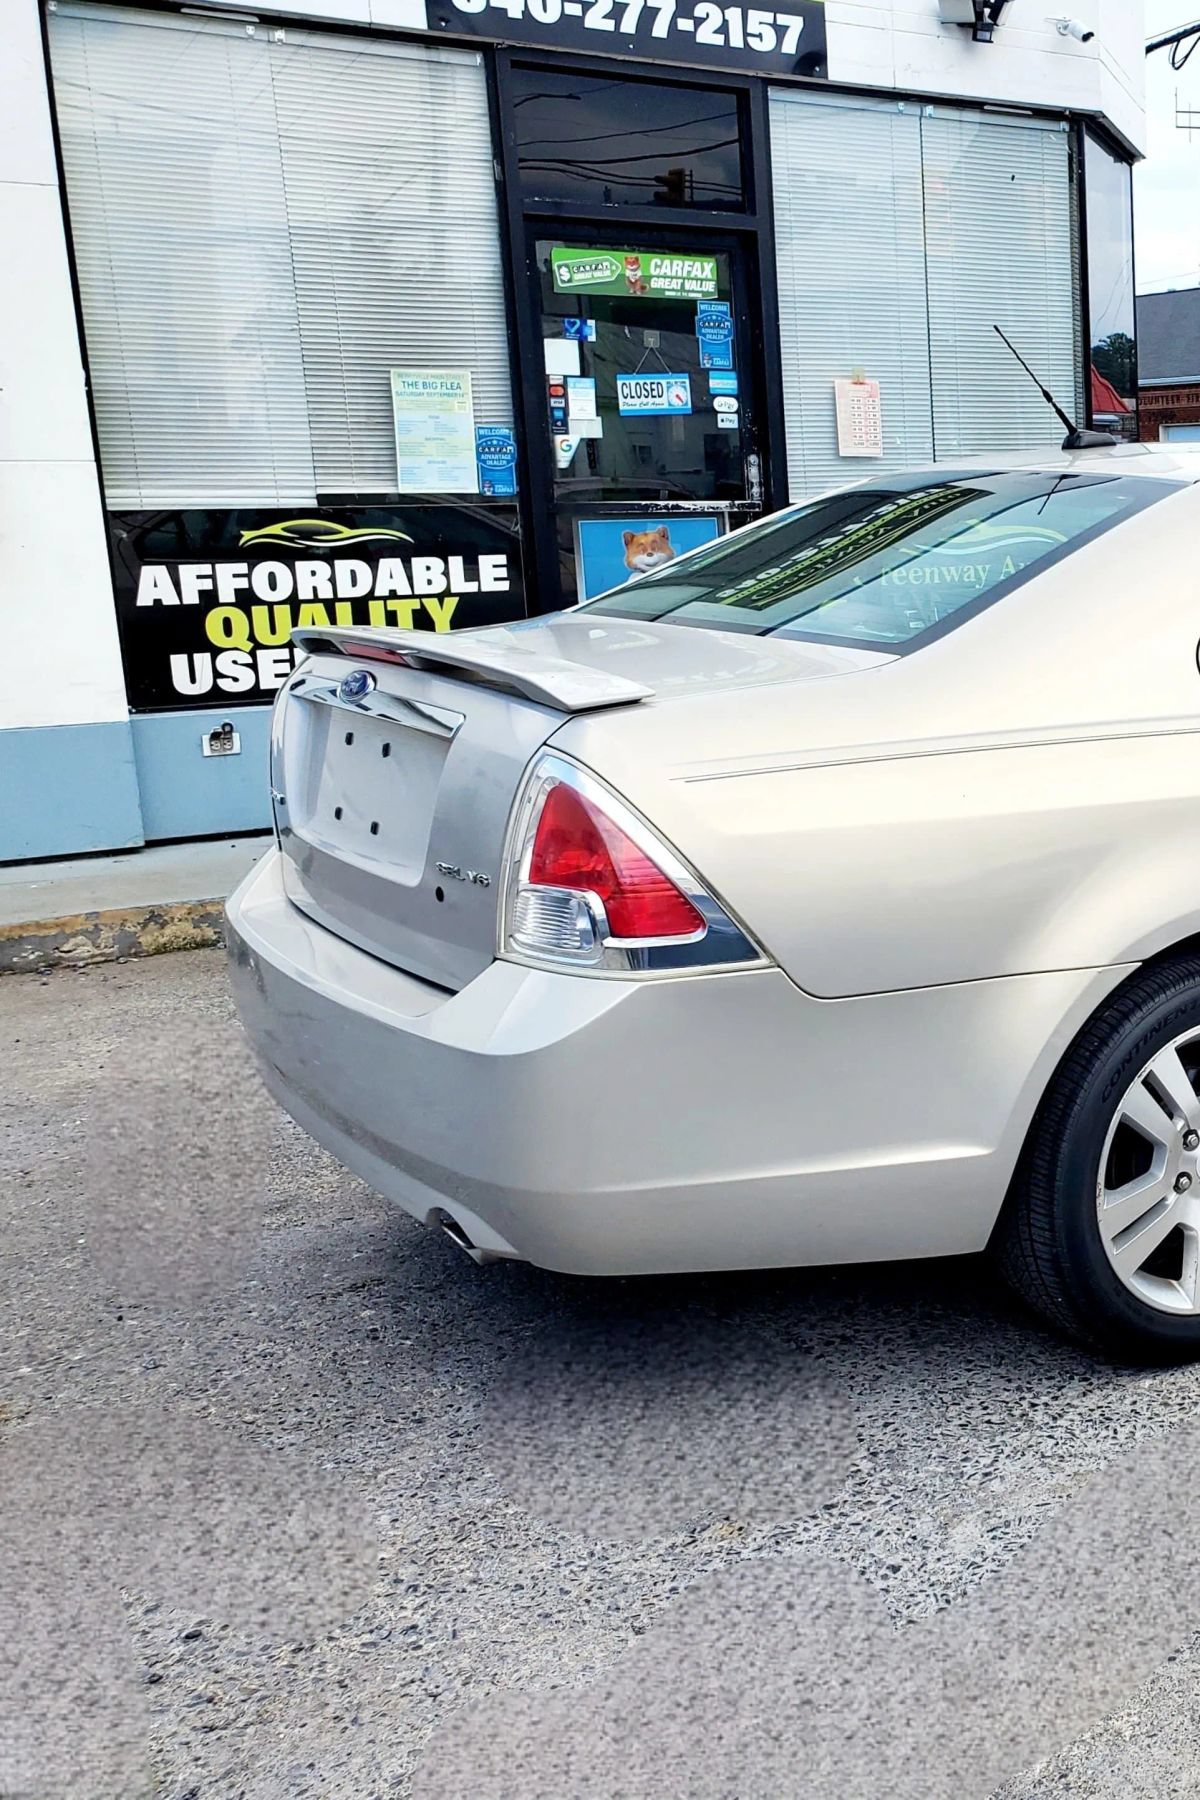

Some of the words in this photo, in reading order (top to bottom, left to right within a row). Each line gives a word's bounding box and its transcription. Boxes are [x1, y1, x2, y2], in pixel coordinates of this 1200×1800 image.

[650, 258, 714, 278] CARFAX
[650, 278, 683, 290] GREAT
[685, 280, 715, 292] VALUE
[401, 381, 420, 390] THE
[422, 381, 438, 390] BIG
[440, 381, 462, 391] FLEA
[621, 382, 664, 399] CLOSED
[478, 428, 510, 436] WELCOME
[136, 554, 511, 607] AFFORDABLE
[169, 648, 306, 695] USE
